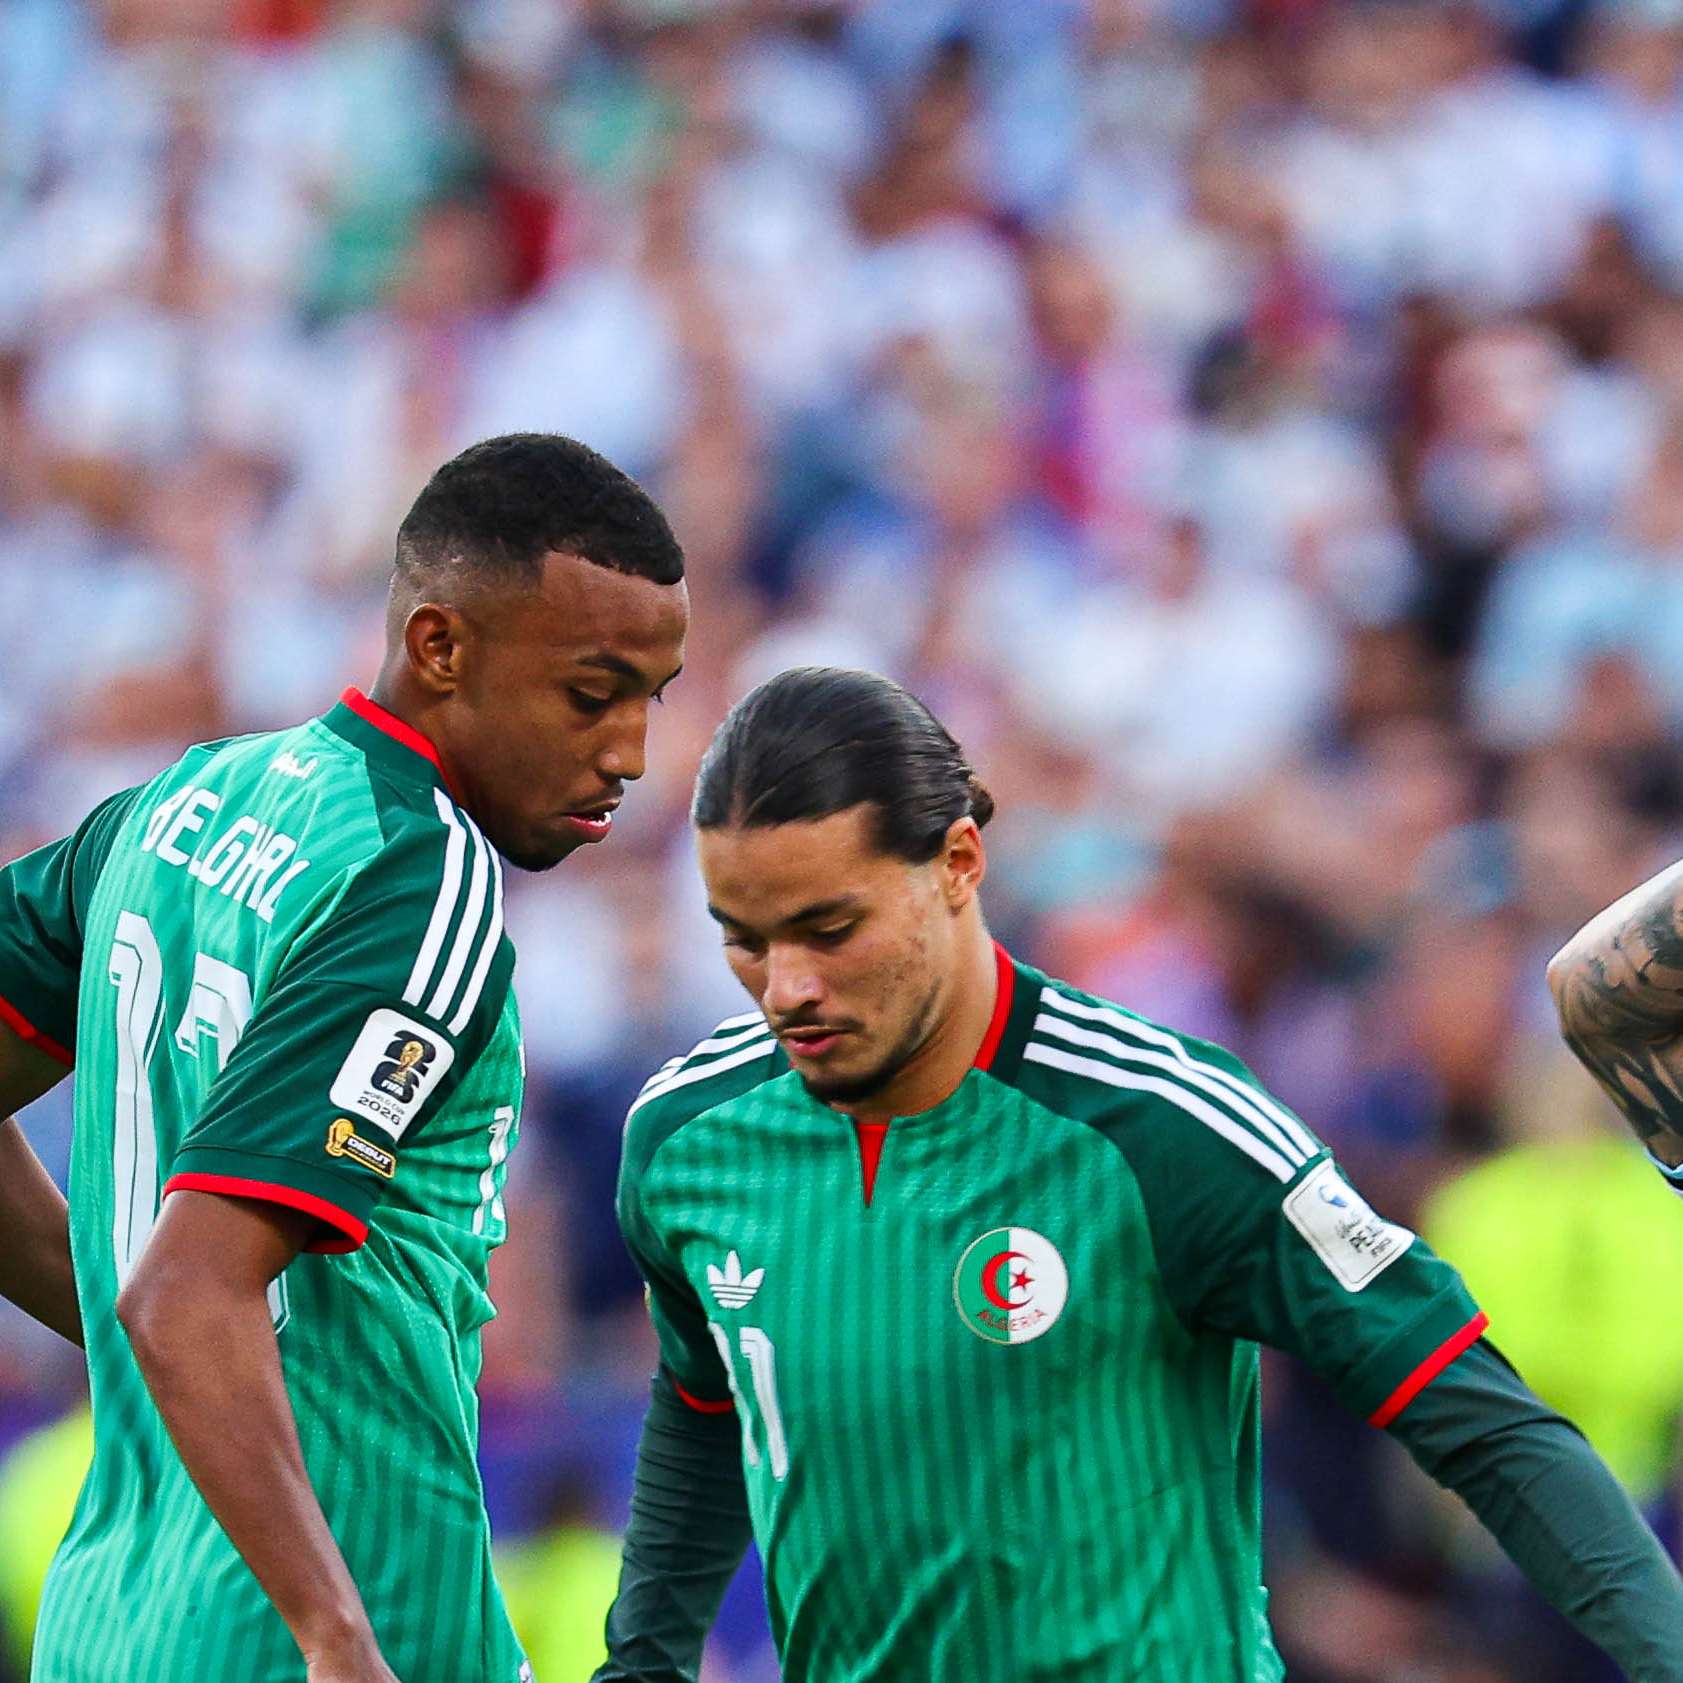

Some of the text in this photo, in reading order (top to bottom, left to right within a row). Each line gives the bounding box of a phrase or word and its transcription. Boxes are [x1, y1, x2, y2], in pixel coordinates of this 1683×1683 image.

[357, 1096, 401, 1126] 2026
[348, 1137, 393, 1165] DEBUT
[976, 1309, 1046, 1331] ALGERIA
[708, 1321, 789, 1482] 11
